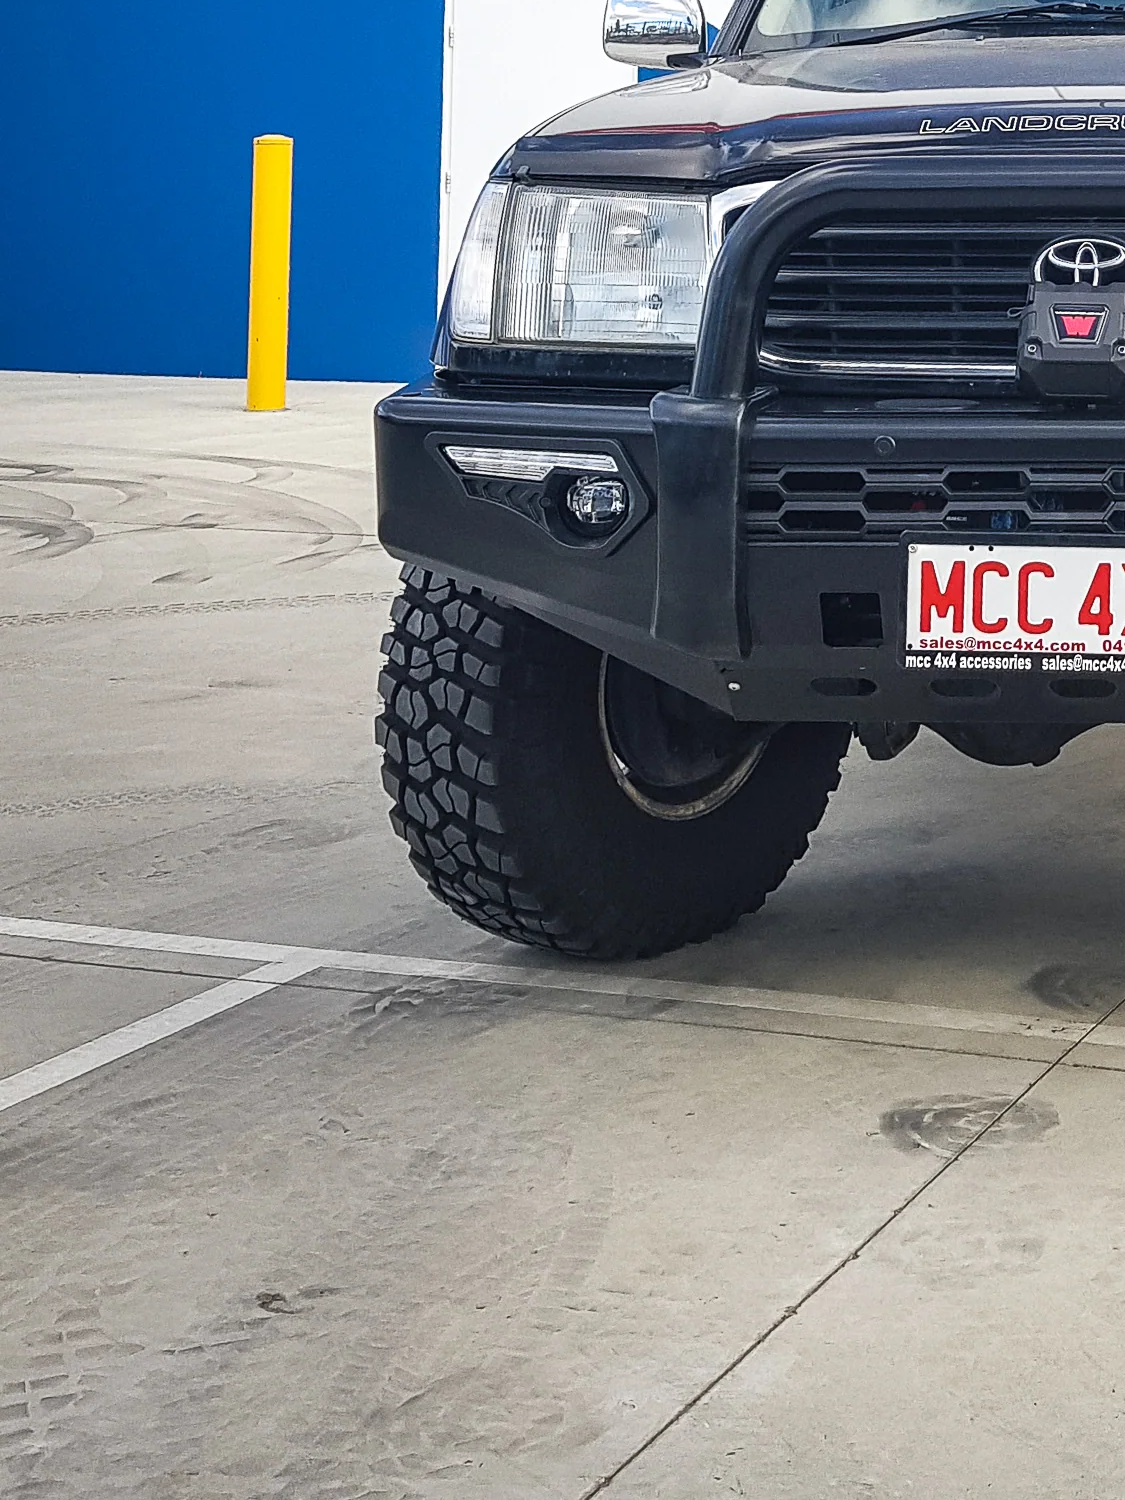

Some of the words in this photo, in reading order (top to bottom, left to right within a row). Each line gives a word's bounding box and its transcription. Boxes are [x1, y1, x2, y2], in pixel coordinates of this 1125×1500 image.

[920, 561, 1054, 635] MCC
[919, 636, 1086, 652] sales@mcc4x4.com
[905, 655, 931, 668] mcc
[934, 652, 957, 668] 4x4
[959, 654, 1032, 670] accessories
